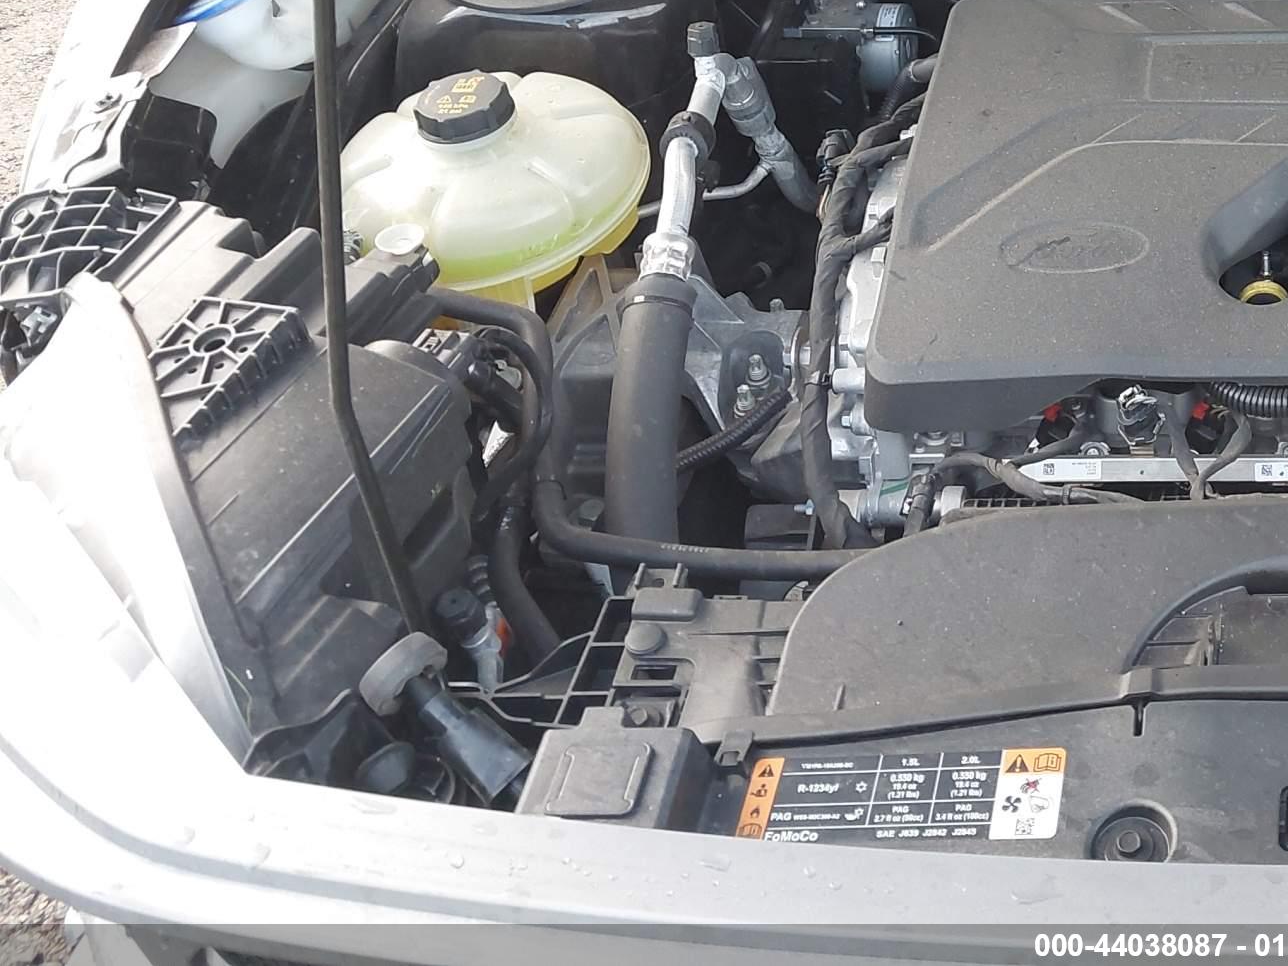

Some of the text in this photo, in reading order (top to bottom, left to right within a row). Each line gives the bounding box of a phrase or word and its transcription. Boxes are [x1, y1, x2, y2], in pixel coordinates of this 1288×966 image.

[797, 783, 840, 795] R-1234yf
[891, 805, 910, 814] PAG
[954, 804, 972, 812] PAG
[770, 812, 792, 822] PAG
[763, 830, 818, 842] FoMoCo
[876, 830, 896, 839] SAE
